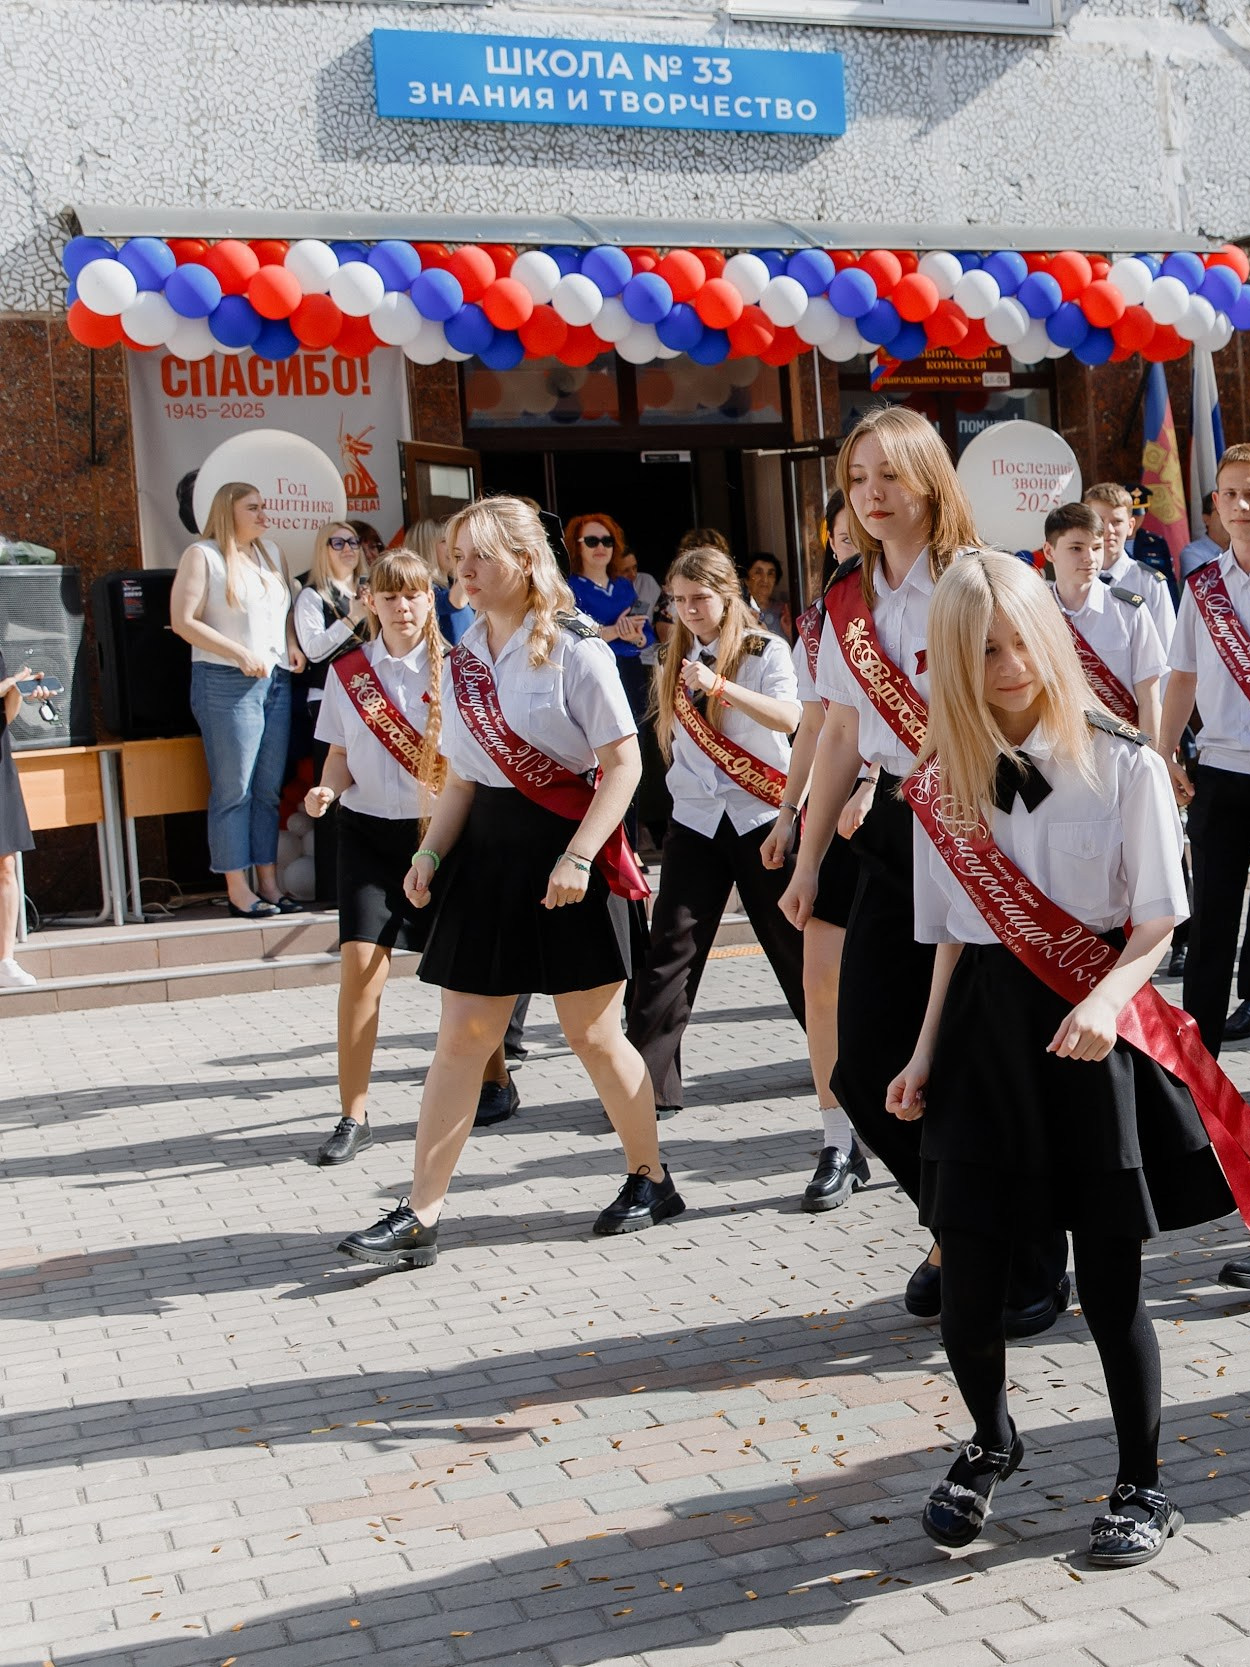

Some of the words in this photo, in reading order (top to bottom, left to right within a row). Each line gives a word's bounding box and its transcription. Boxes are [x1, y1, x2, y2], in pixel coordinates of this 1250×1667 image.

[485, 46, 633, 81] ШКОЛА
[644, 54, 683, 83] №
[692, 56, 732, 86] 33
[408, 81, 554, 111] ЗНАНИЯ
[568, 88, 588, 111] И
[600, 89, 817, 121] ТВОРЧЕСТВО
[160, 354, 371, 398] СПАСИБО!
[926, 360, 986, 370] КОМИССИЯ
[276, 477, 308, 497] Год
[459, 657, 512, 757] Выпускница
[503, 744, 565, 787] 2025
[726, 757, 752, 775] 9
